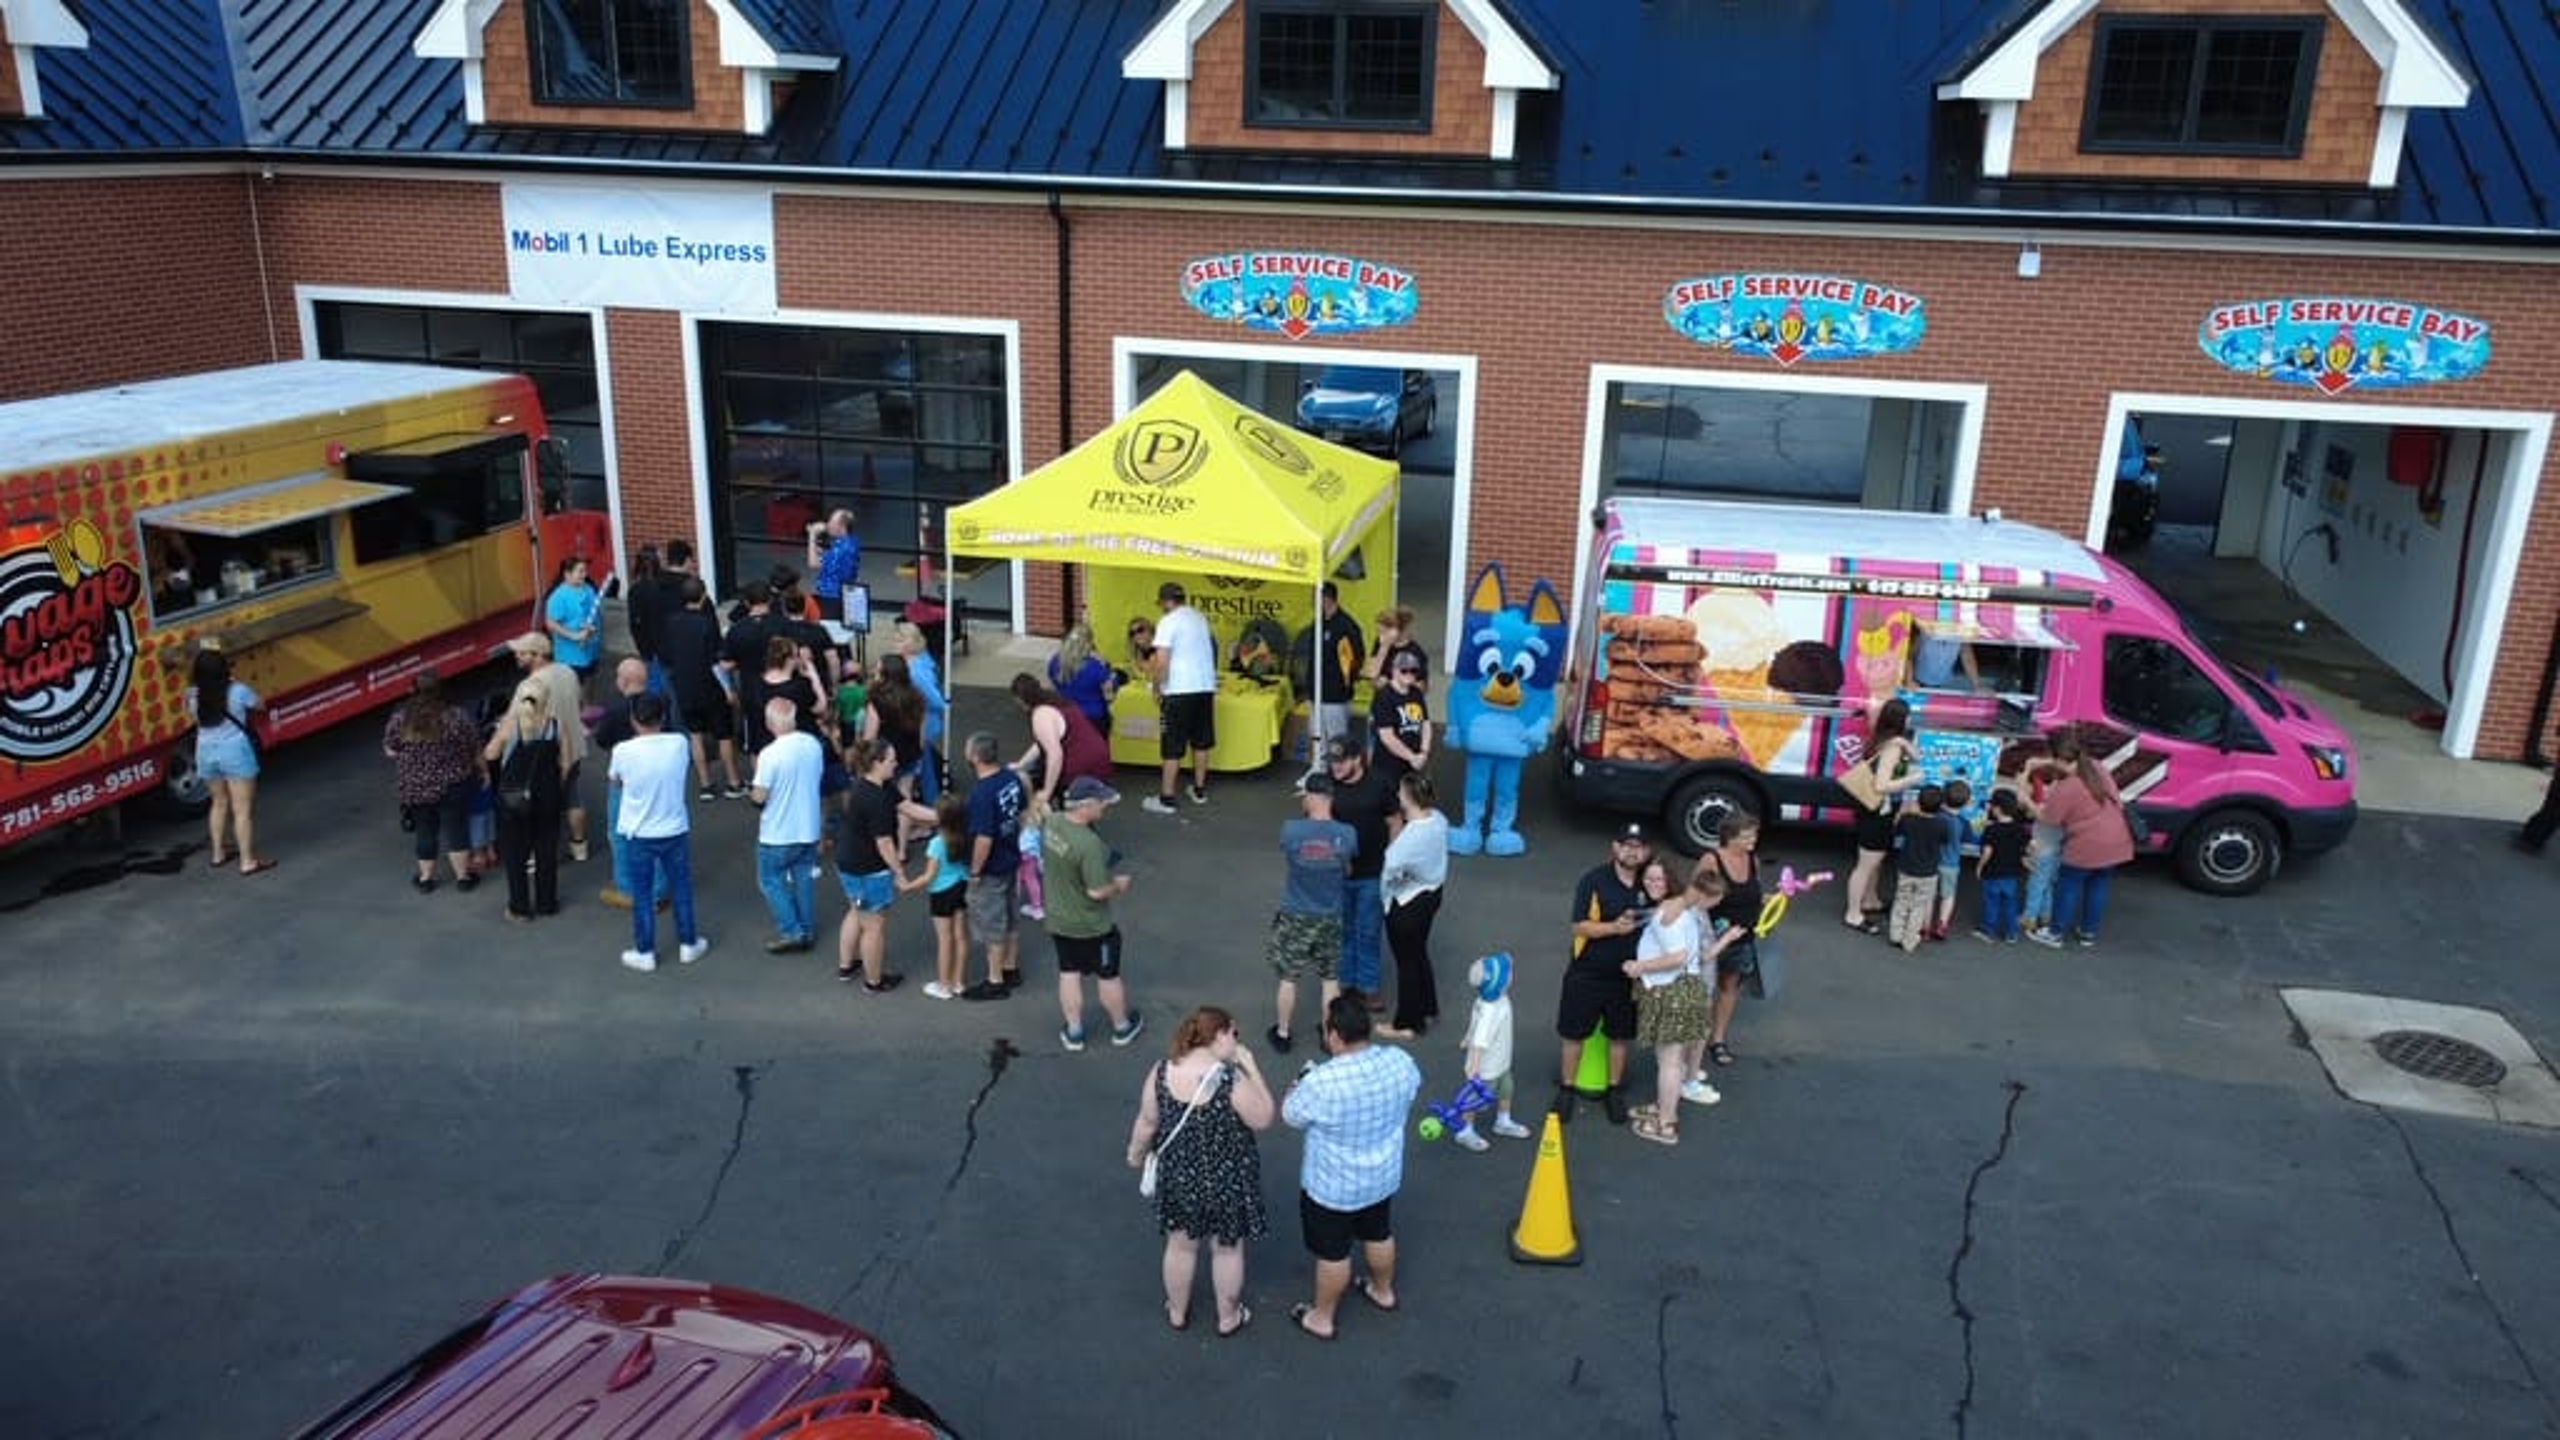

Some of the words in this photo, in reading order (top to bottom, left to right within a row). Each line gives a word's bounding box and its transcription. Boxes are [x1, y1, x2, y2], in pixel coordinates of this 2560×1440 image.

[512, 230, 569, 252] Mobil
[577, 233, 588, 254] 1
[599, 234, 658, 257] Lube
[666, 237, 767, 265] Express
[1190, 258, 1243, 284] SELF
[1252, 256, 1350, 277] SERVICE
[1359, 265, 1407, 291] BAY
[1676, 279, 1735, 305] SELF
[1744, 278, 1853, 301] SERVICE
[1862, 287, 1916, 315] BAY
[2214, 304, 2281, 331] SELF
[2290, 302, 2412, 327] SERVICE
[2421, 313, 2480, 341] BAY
[1139, 431, 1186, 466] P
[1088, 488, 1196, 516] prestige
[2, 759, 155, 834] 781-562-9516
